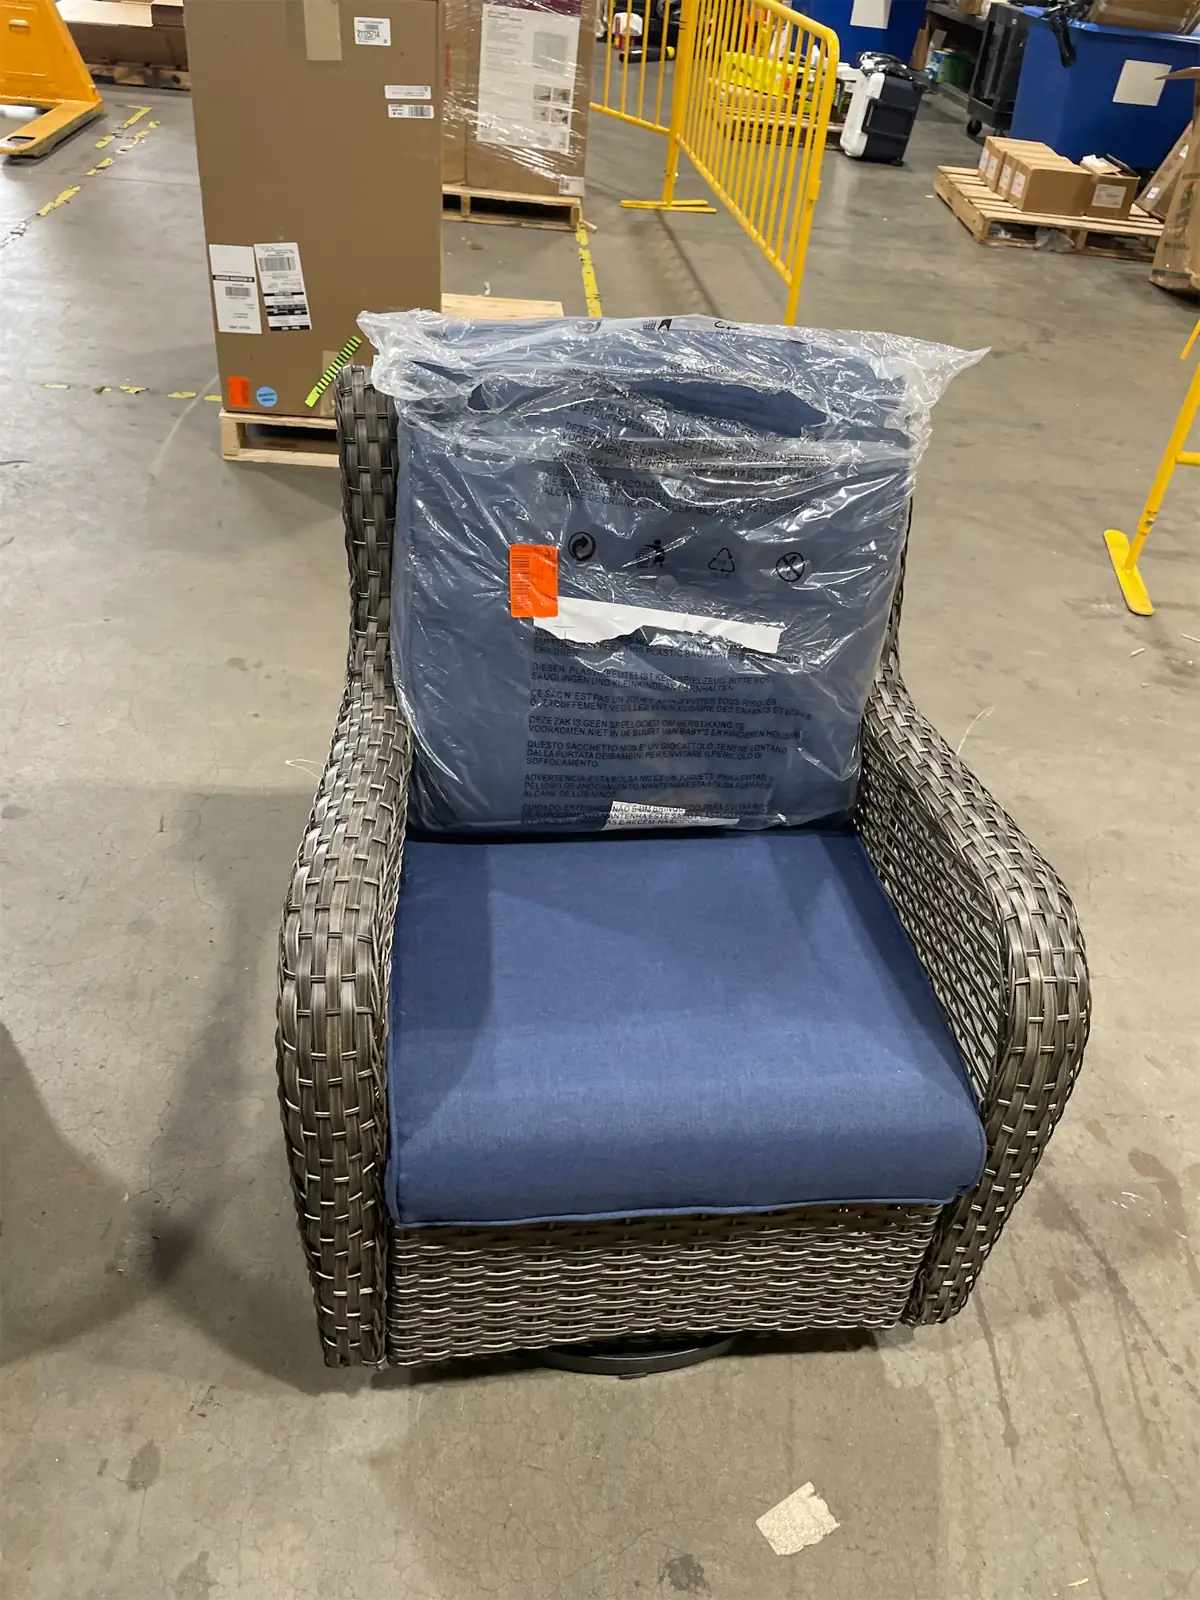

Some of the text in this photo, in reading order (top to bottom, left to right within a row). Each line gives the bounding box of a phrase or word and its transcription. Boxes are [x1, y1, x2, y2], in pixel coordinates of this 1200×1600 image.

[565, 421, 589, 435] DEZE
[646, 647, 683, 657] PLASTIC
[684, 649, 703, 658] BAG
[532, 662, 565, 673] DIESER
[529, 715, 553, 724] DEZE
[555, 717, 570, 726] ZAK
[573, 718, 581, 726] IS
[583, 719, 607, 728] GEEN
[735, 721, 745, 730] TE
[662, 727, 678, 736] VAN
[527, 740, 563, 750] QUESTO
[565, 742, 618, 752] SACCHETTO
[527, 748, 555, 757] DALLA
[526, 757, 598, 768] SOFFOCAMENTO
